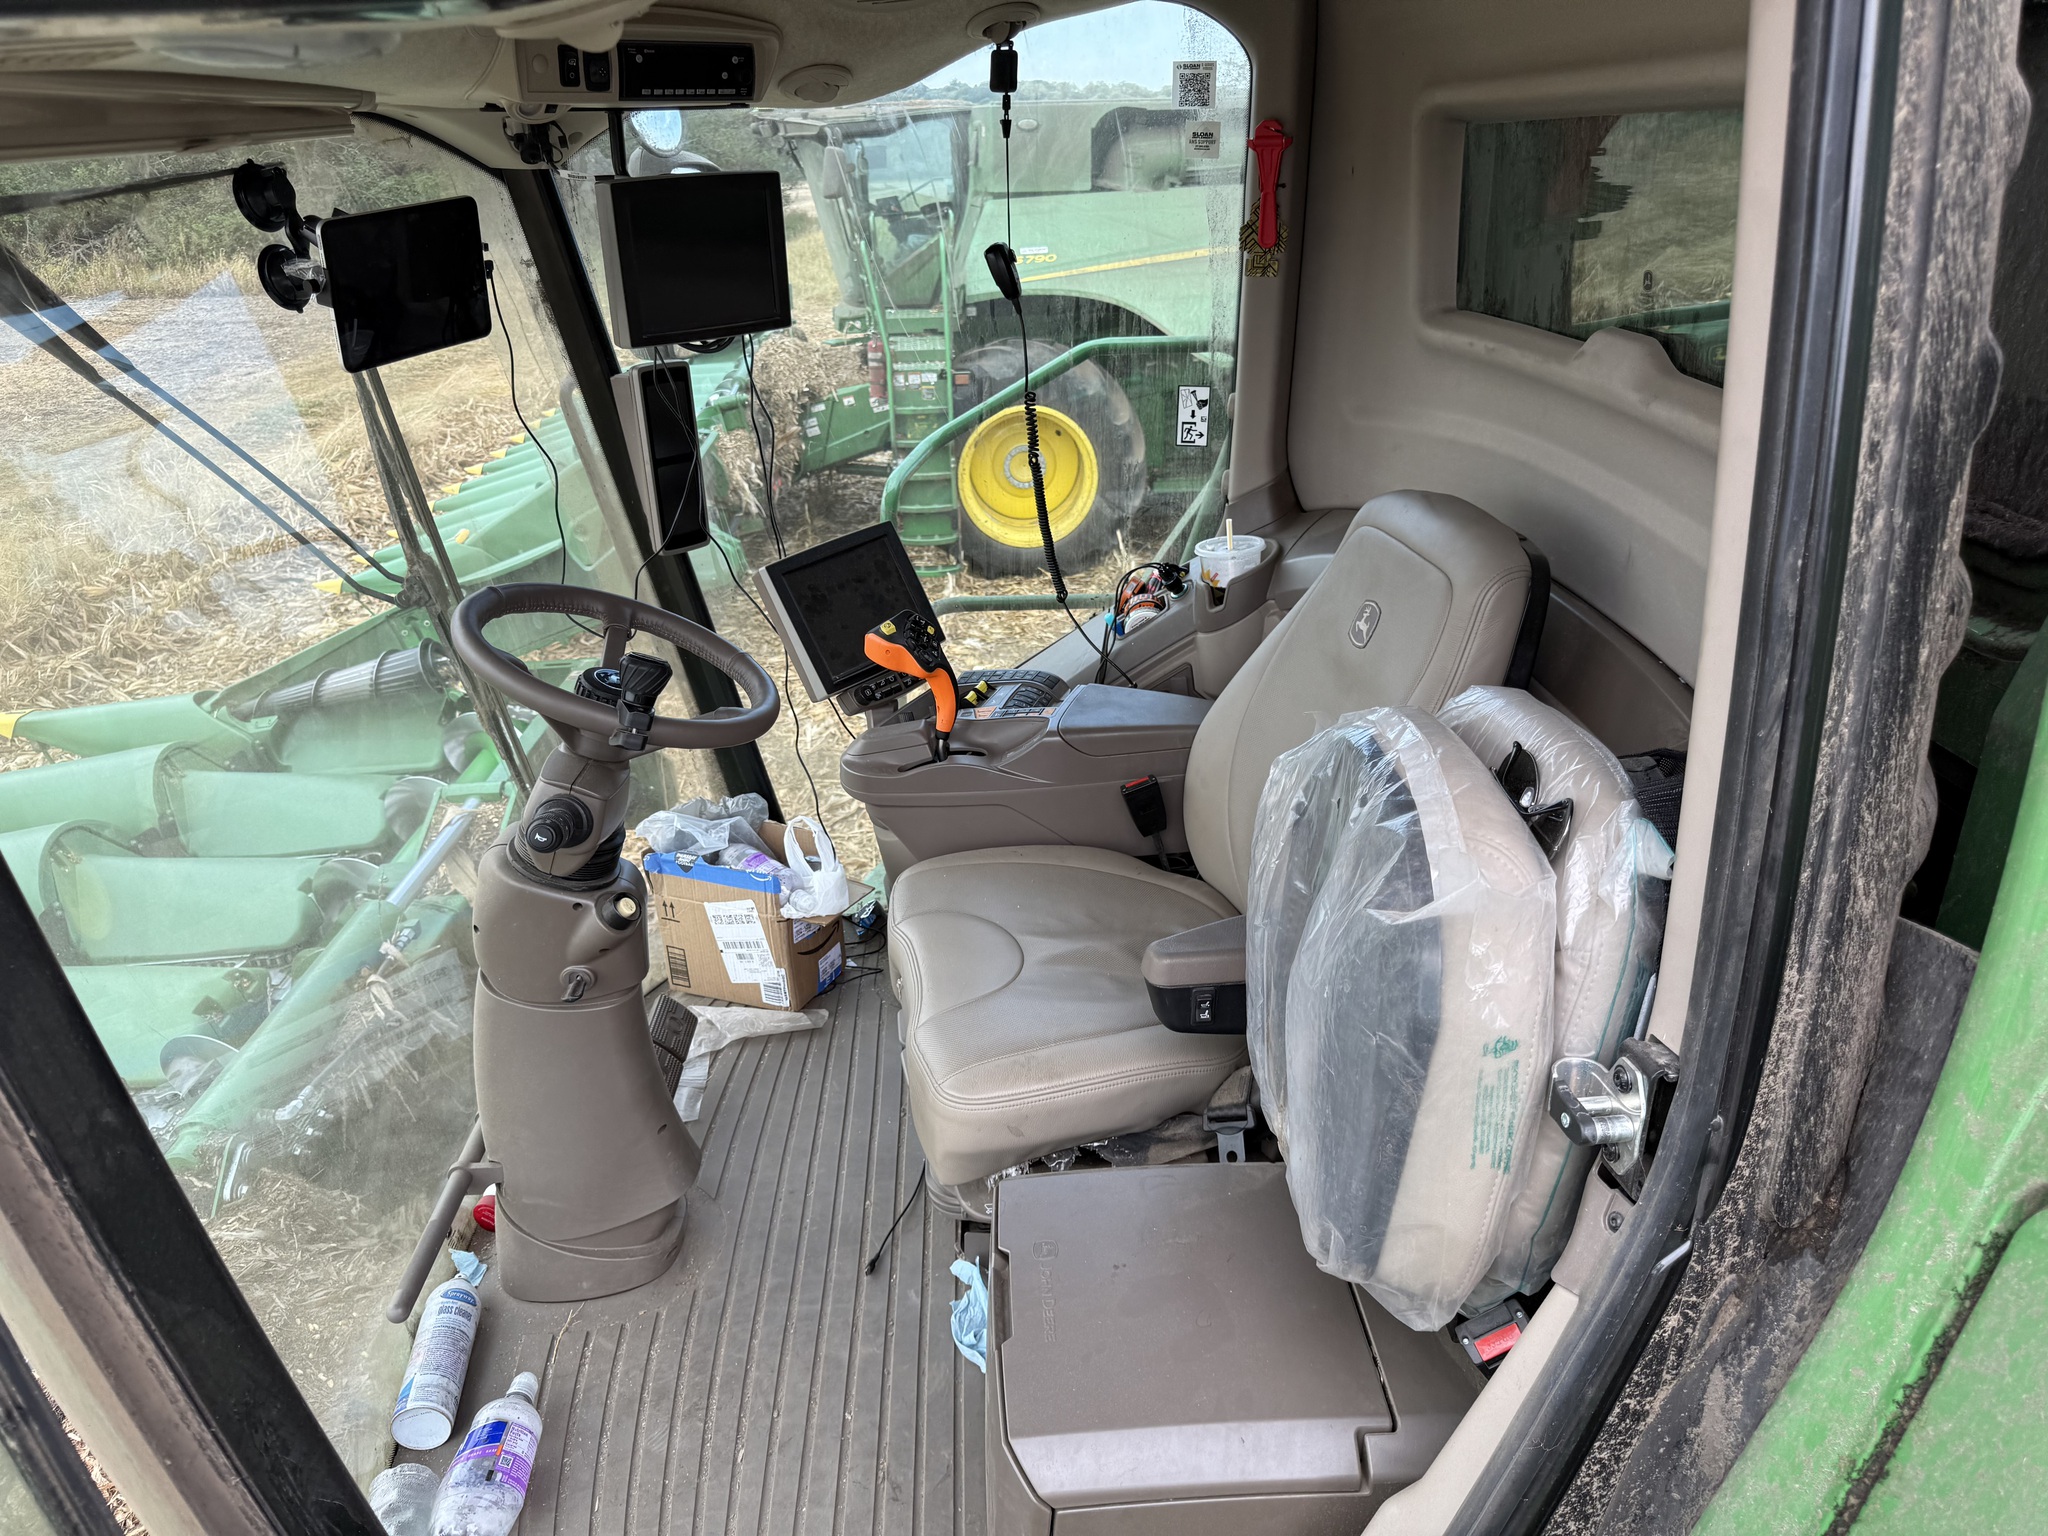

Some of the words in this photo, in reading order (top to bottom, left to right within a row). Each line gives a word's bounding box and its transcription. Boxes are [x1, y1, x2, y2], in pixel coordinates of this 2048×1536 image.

[1040, 1263, 1053, 1297] JOHN
[447, 1290, 475, 1303] Sprayway
[438, 1305, 454, 1316] glass
[454, 1306, 472, 1322] cleaner
[1041, 1298, 1056, 1343] DEERE
